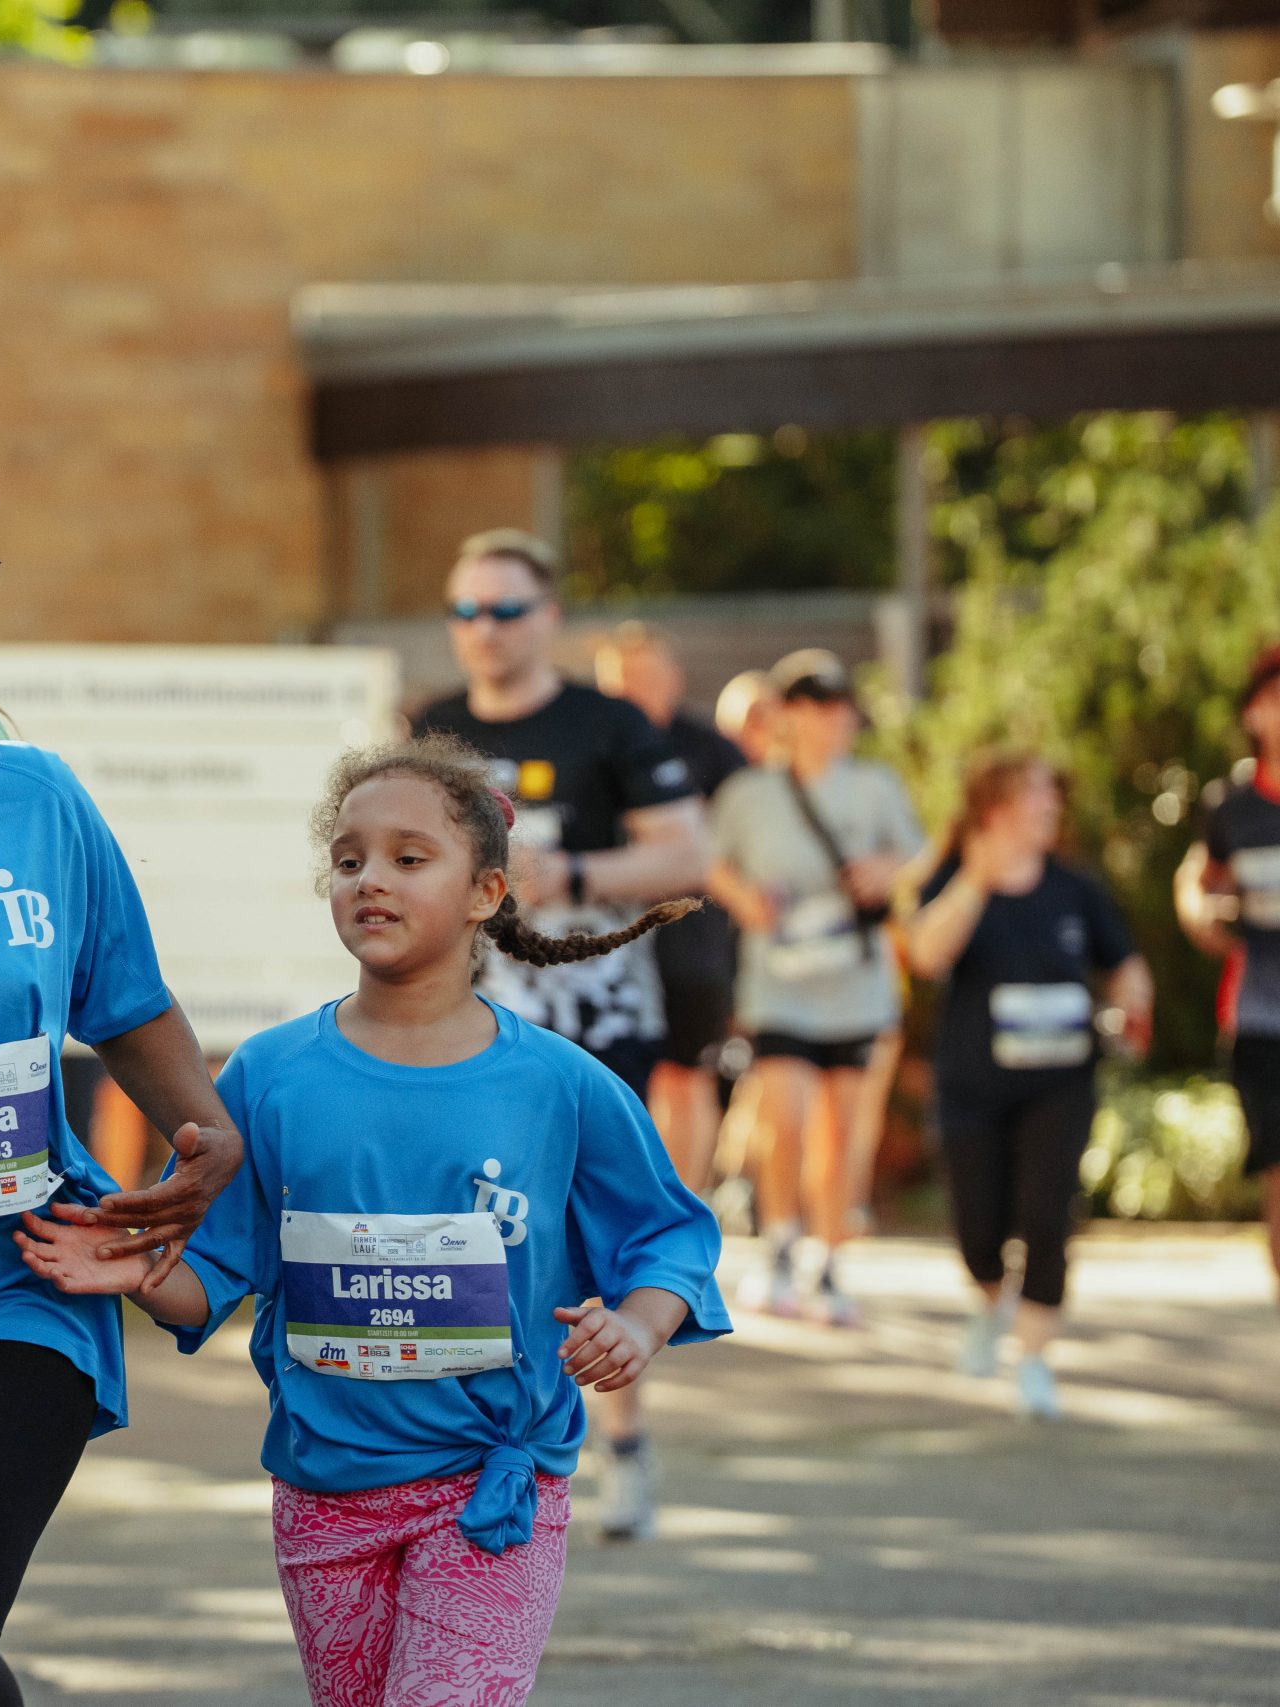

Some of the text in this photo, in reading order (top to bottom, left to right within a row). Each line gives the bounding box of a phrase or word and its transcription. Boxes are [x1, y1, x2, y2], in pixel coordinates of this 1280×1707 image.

[354, 1222, 367, 1230] dm
[354, 1245, 376, 1254] LAUF
[331, 1266, 453, 1300] Larissa
[370, 1308, 415, 1326] 2694
[319, 1342, 346, 1360] dm
[425, 1347, 483, 1356] BIONTECH
